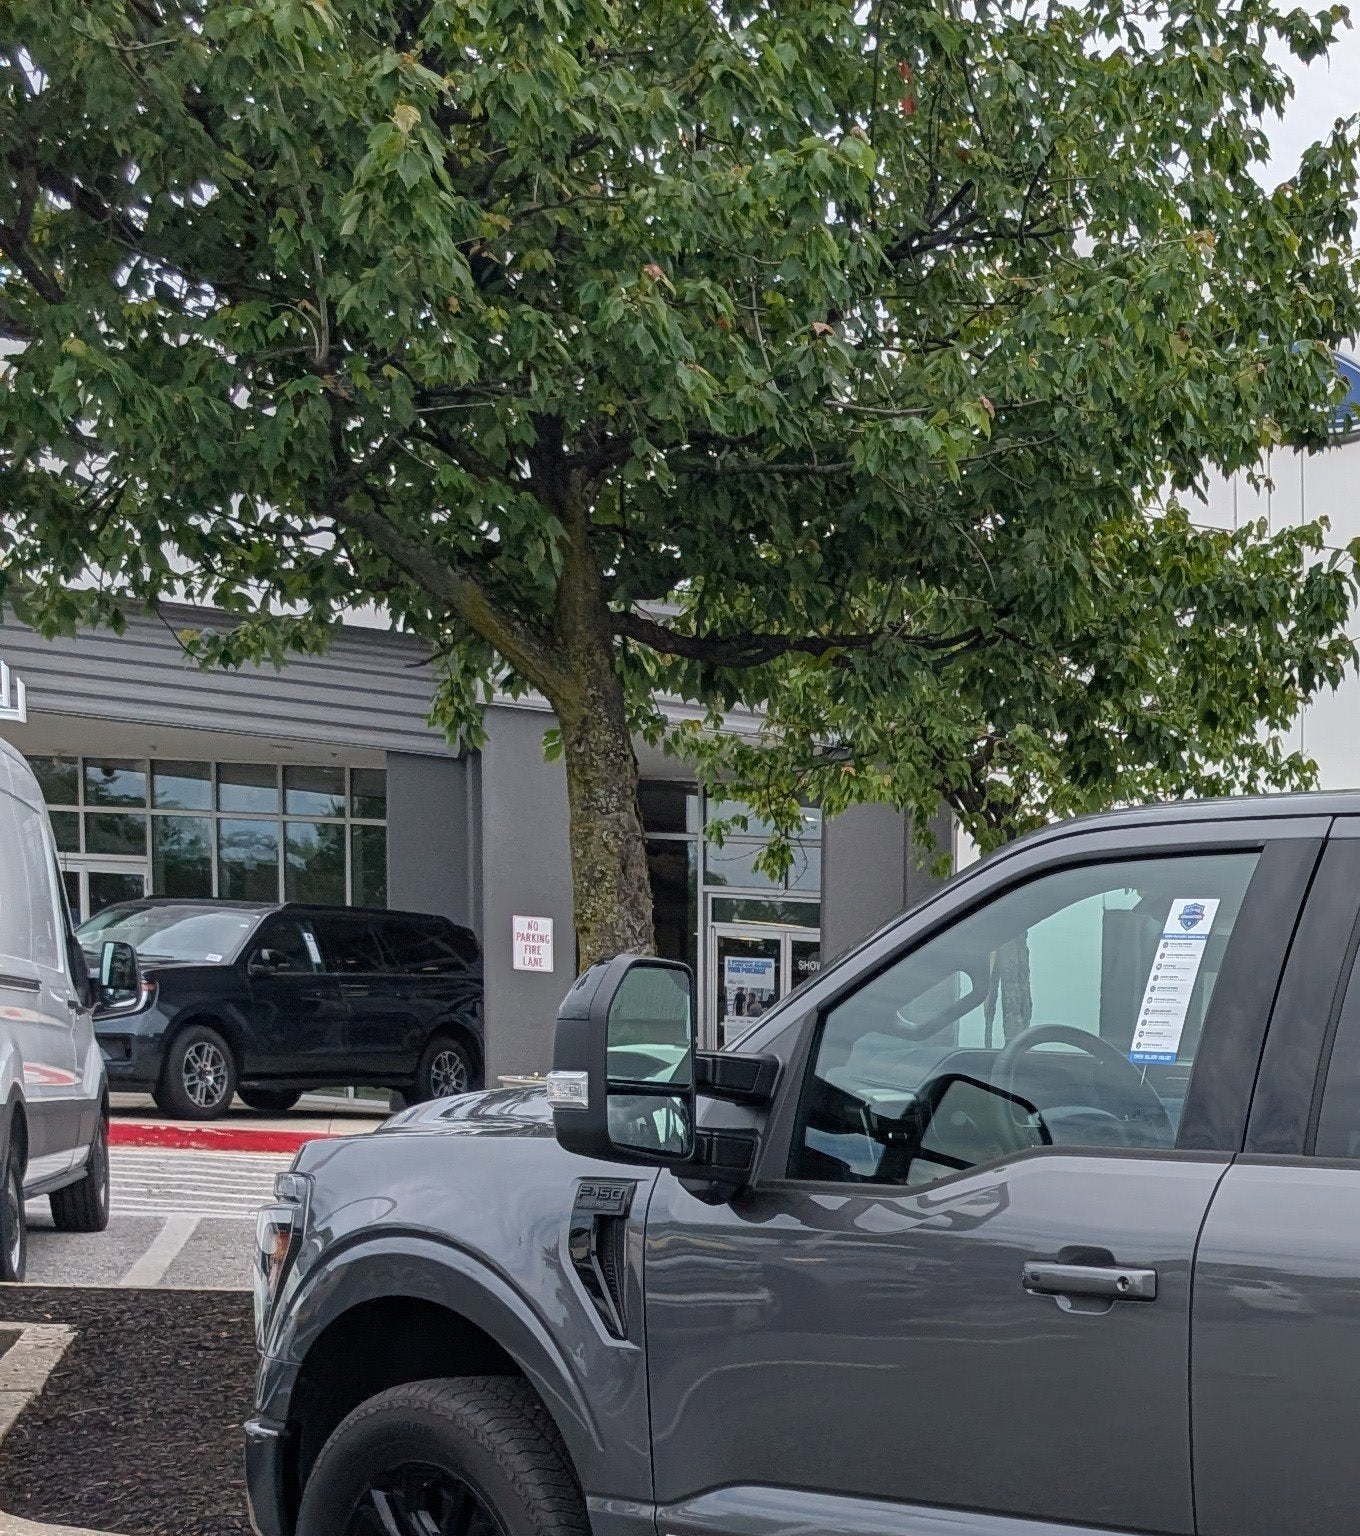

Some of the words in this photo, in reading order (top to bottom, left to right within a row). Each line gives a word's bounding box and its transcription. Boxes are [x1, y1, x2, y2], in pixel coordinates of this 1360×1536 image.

[527, 921, 539, 931] NO
[516, 932, 551, 944] PARKING
[524, 944, 542, 955] FIRE
[522, 956, 543, 967] LANE
